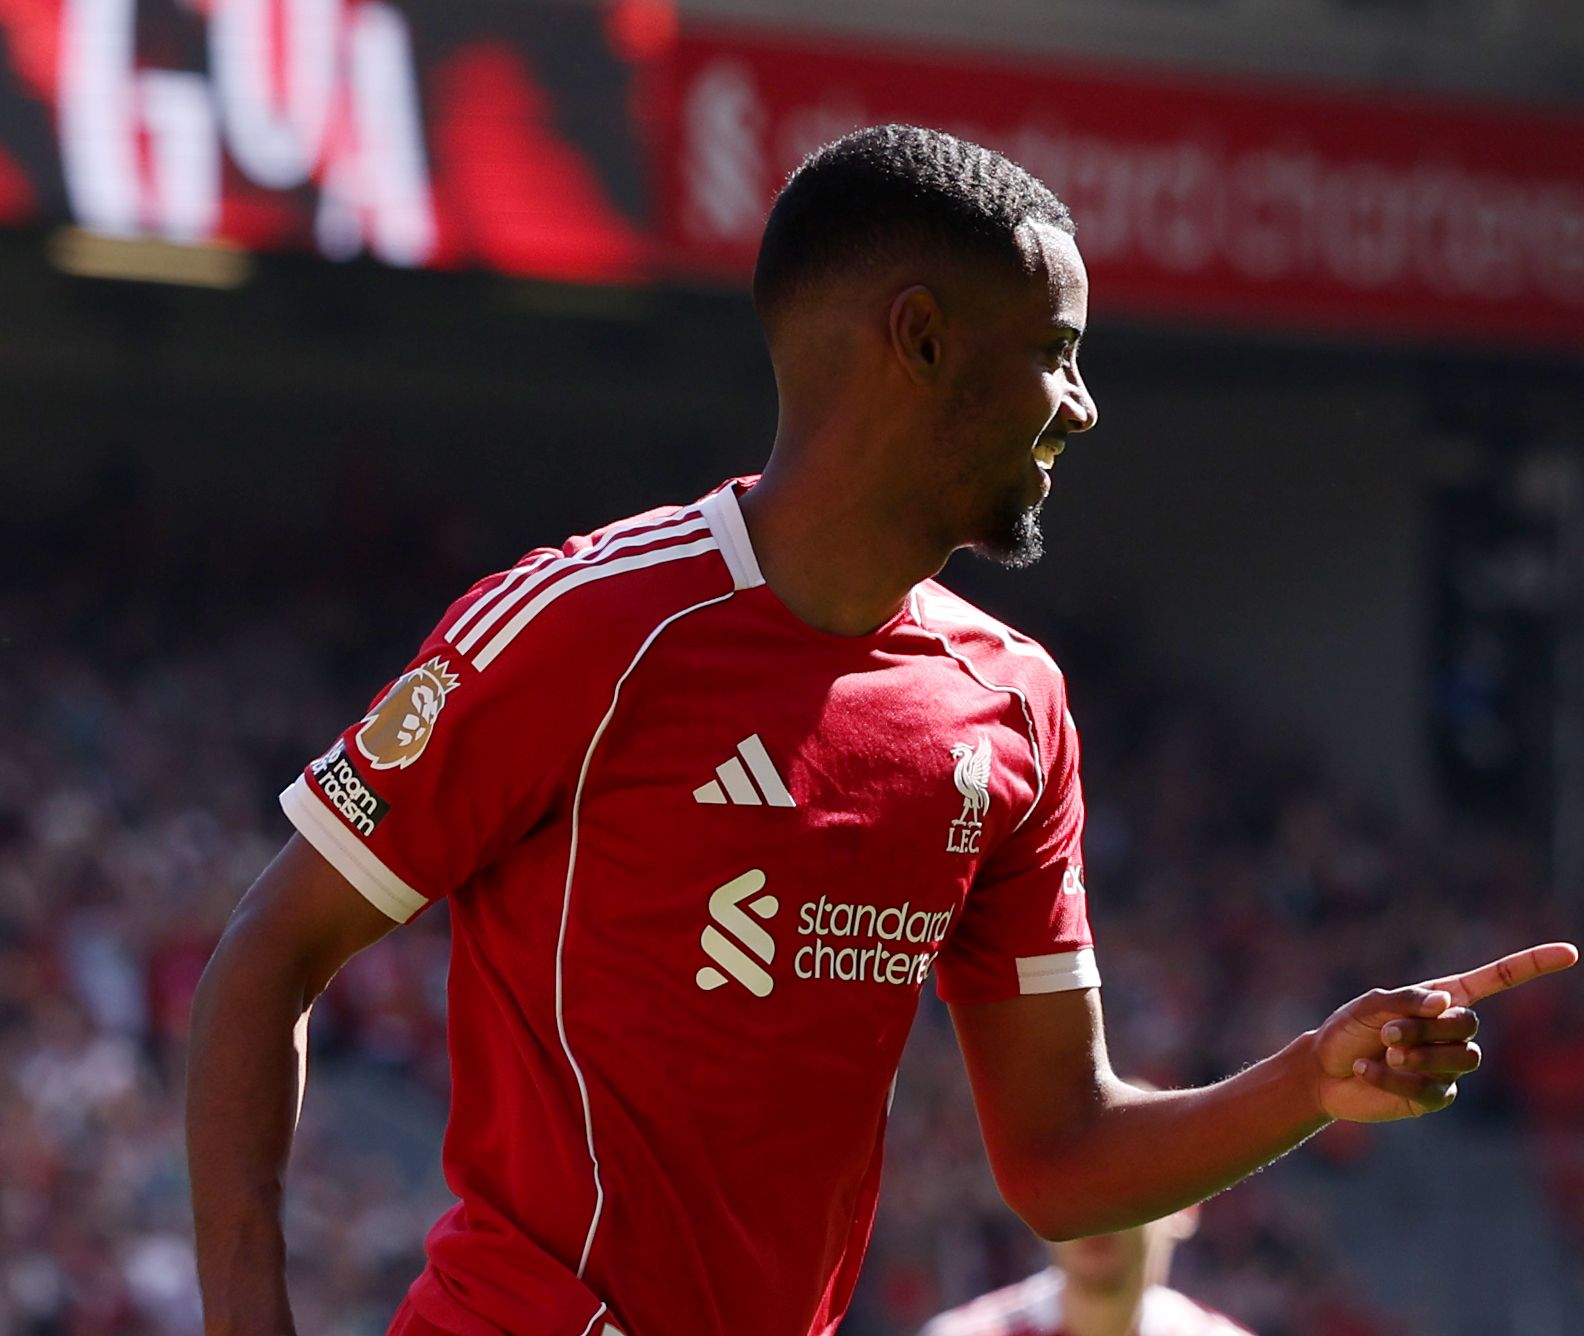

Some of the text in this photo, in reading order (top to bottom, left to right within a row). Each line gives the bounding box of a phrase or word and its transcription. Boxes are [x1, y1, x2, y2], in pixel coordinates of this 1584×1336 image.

[318, 771, 375, 837] racism
[333, 758, 377, 815] room
[797, 894, 956, 943] standard
